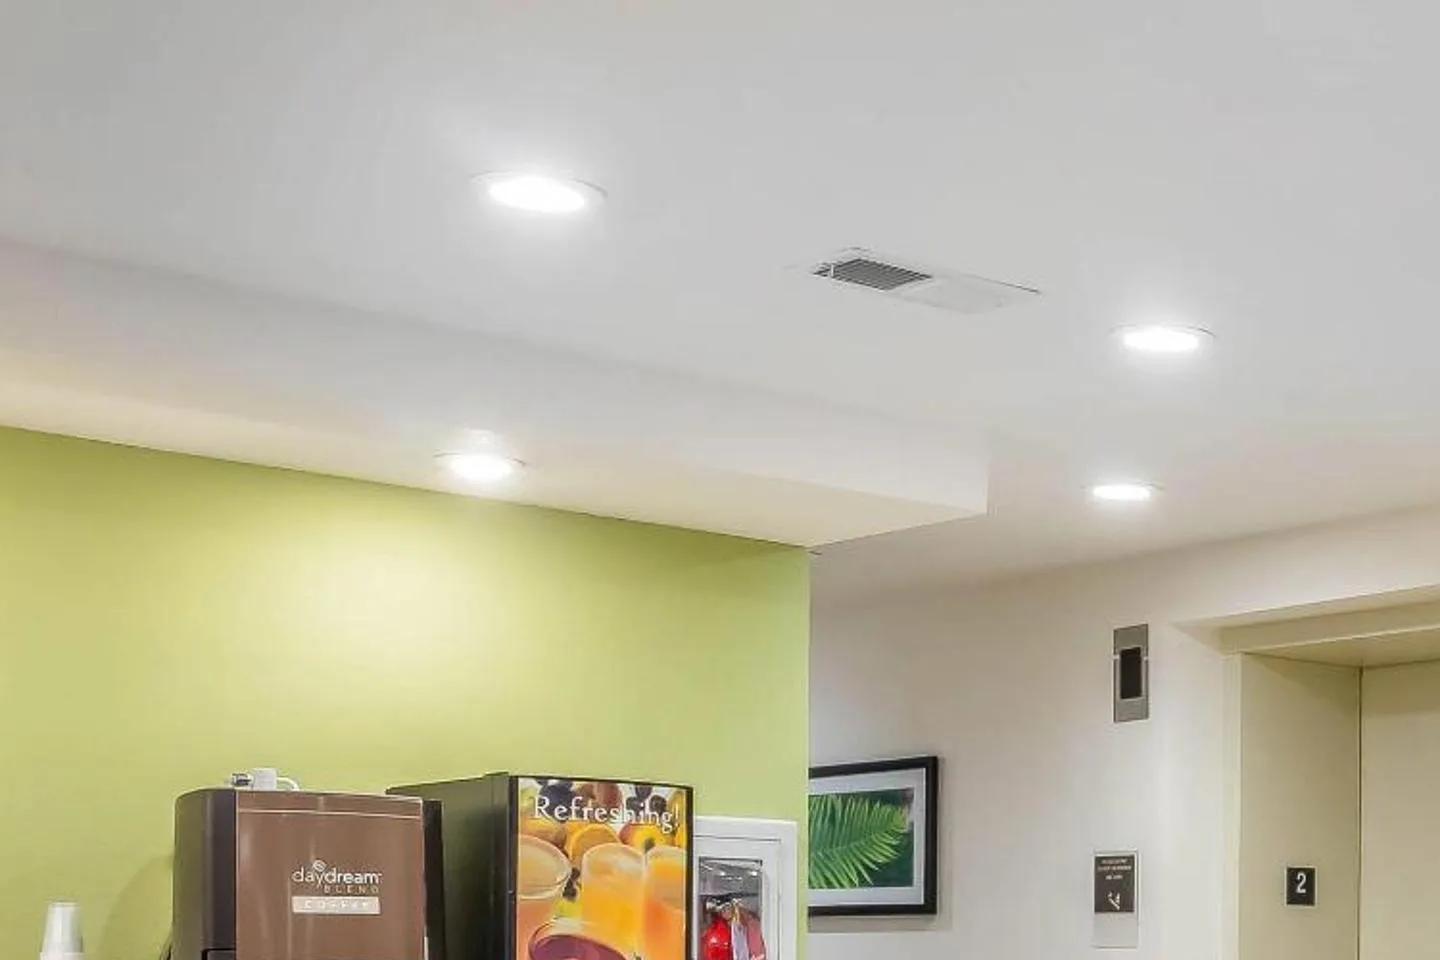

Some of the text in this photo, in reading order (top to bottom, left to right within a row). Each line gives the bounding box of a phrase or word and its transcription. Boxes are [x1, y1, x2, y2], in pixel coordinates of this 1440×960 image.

[532, 795, 681, 834] Refreshing!
[291, 866, 380, 889] daydream
[1296, 871, 1307, 894] 2
